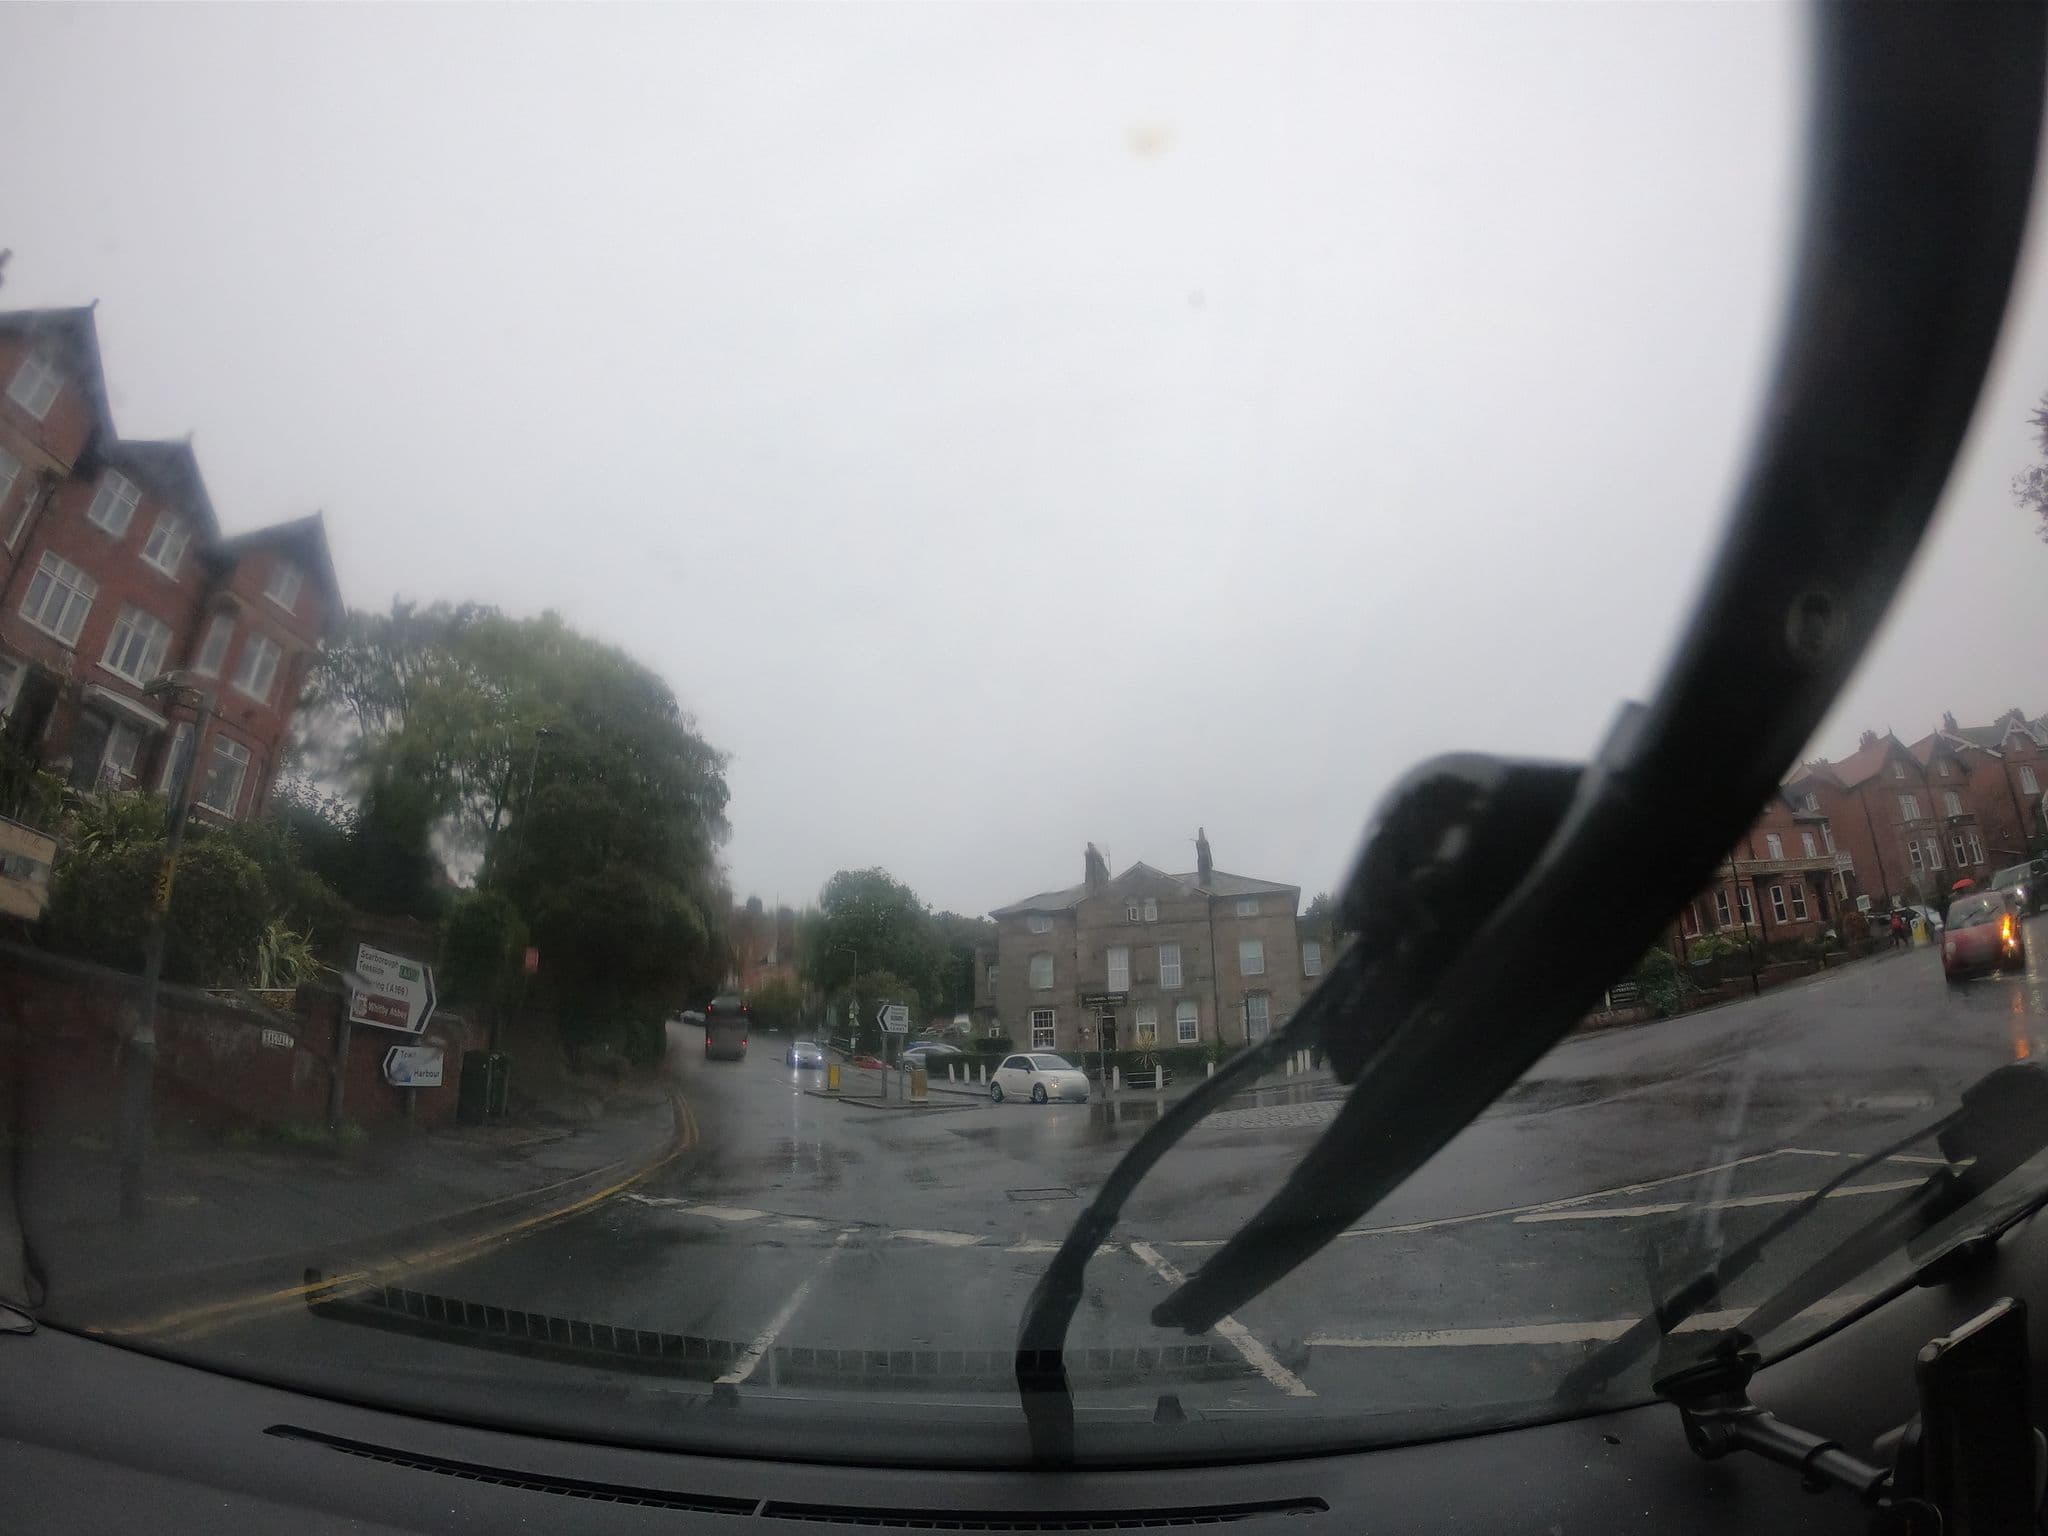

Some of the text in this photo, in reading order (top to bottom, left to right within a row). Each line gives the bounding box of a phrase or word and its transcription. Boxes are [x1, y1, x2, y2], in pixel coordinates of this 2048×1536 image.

[360, 949, 400, 970] Scarborough
[368, 1001, 389, 1017] Whitby
[414, 1068, 440, 1078] Harbour
